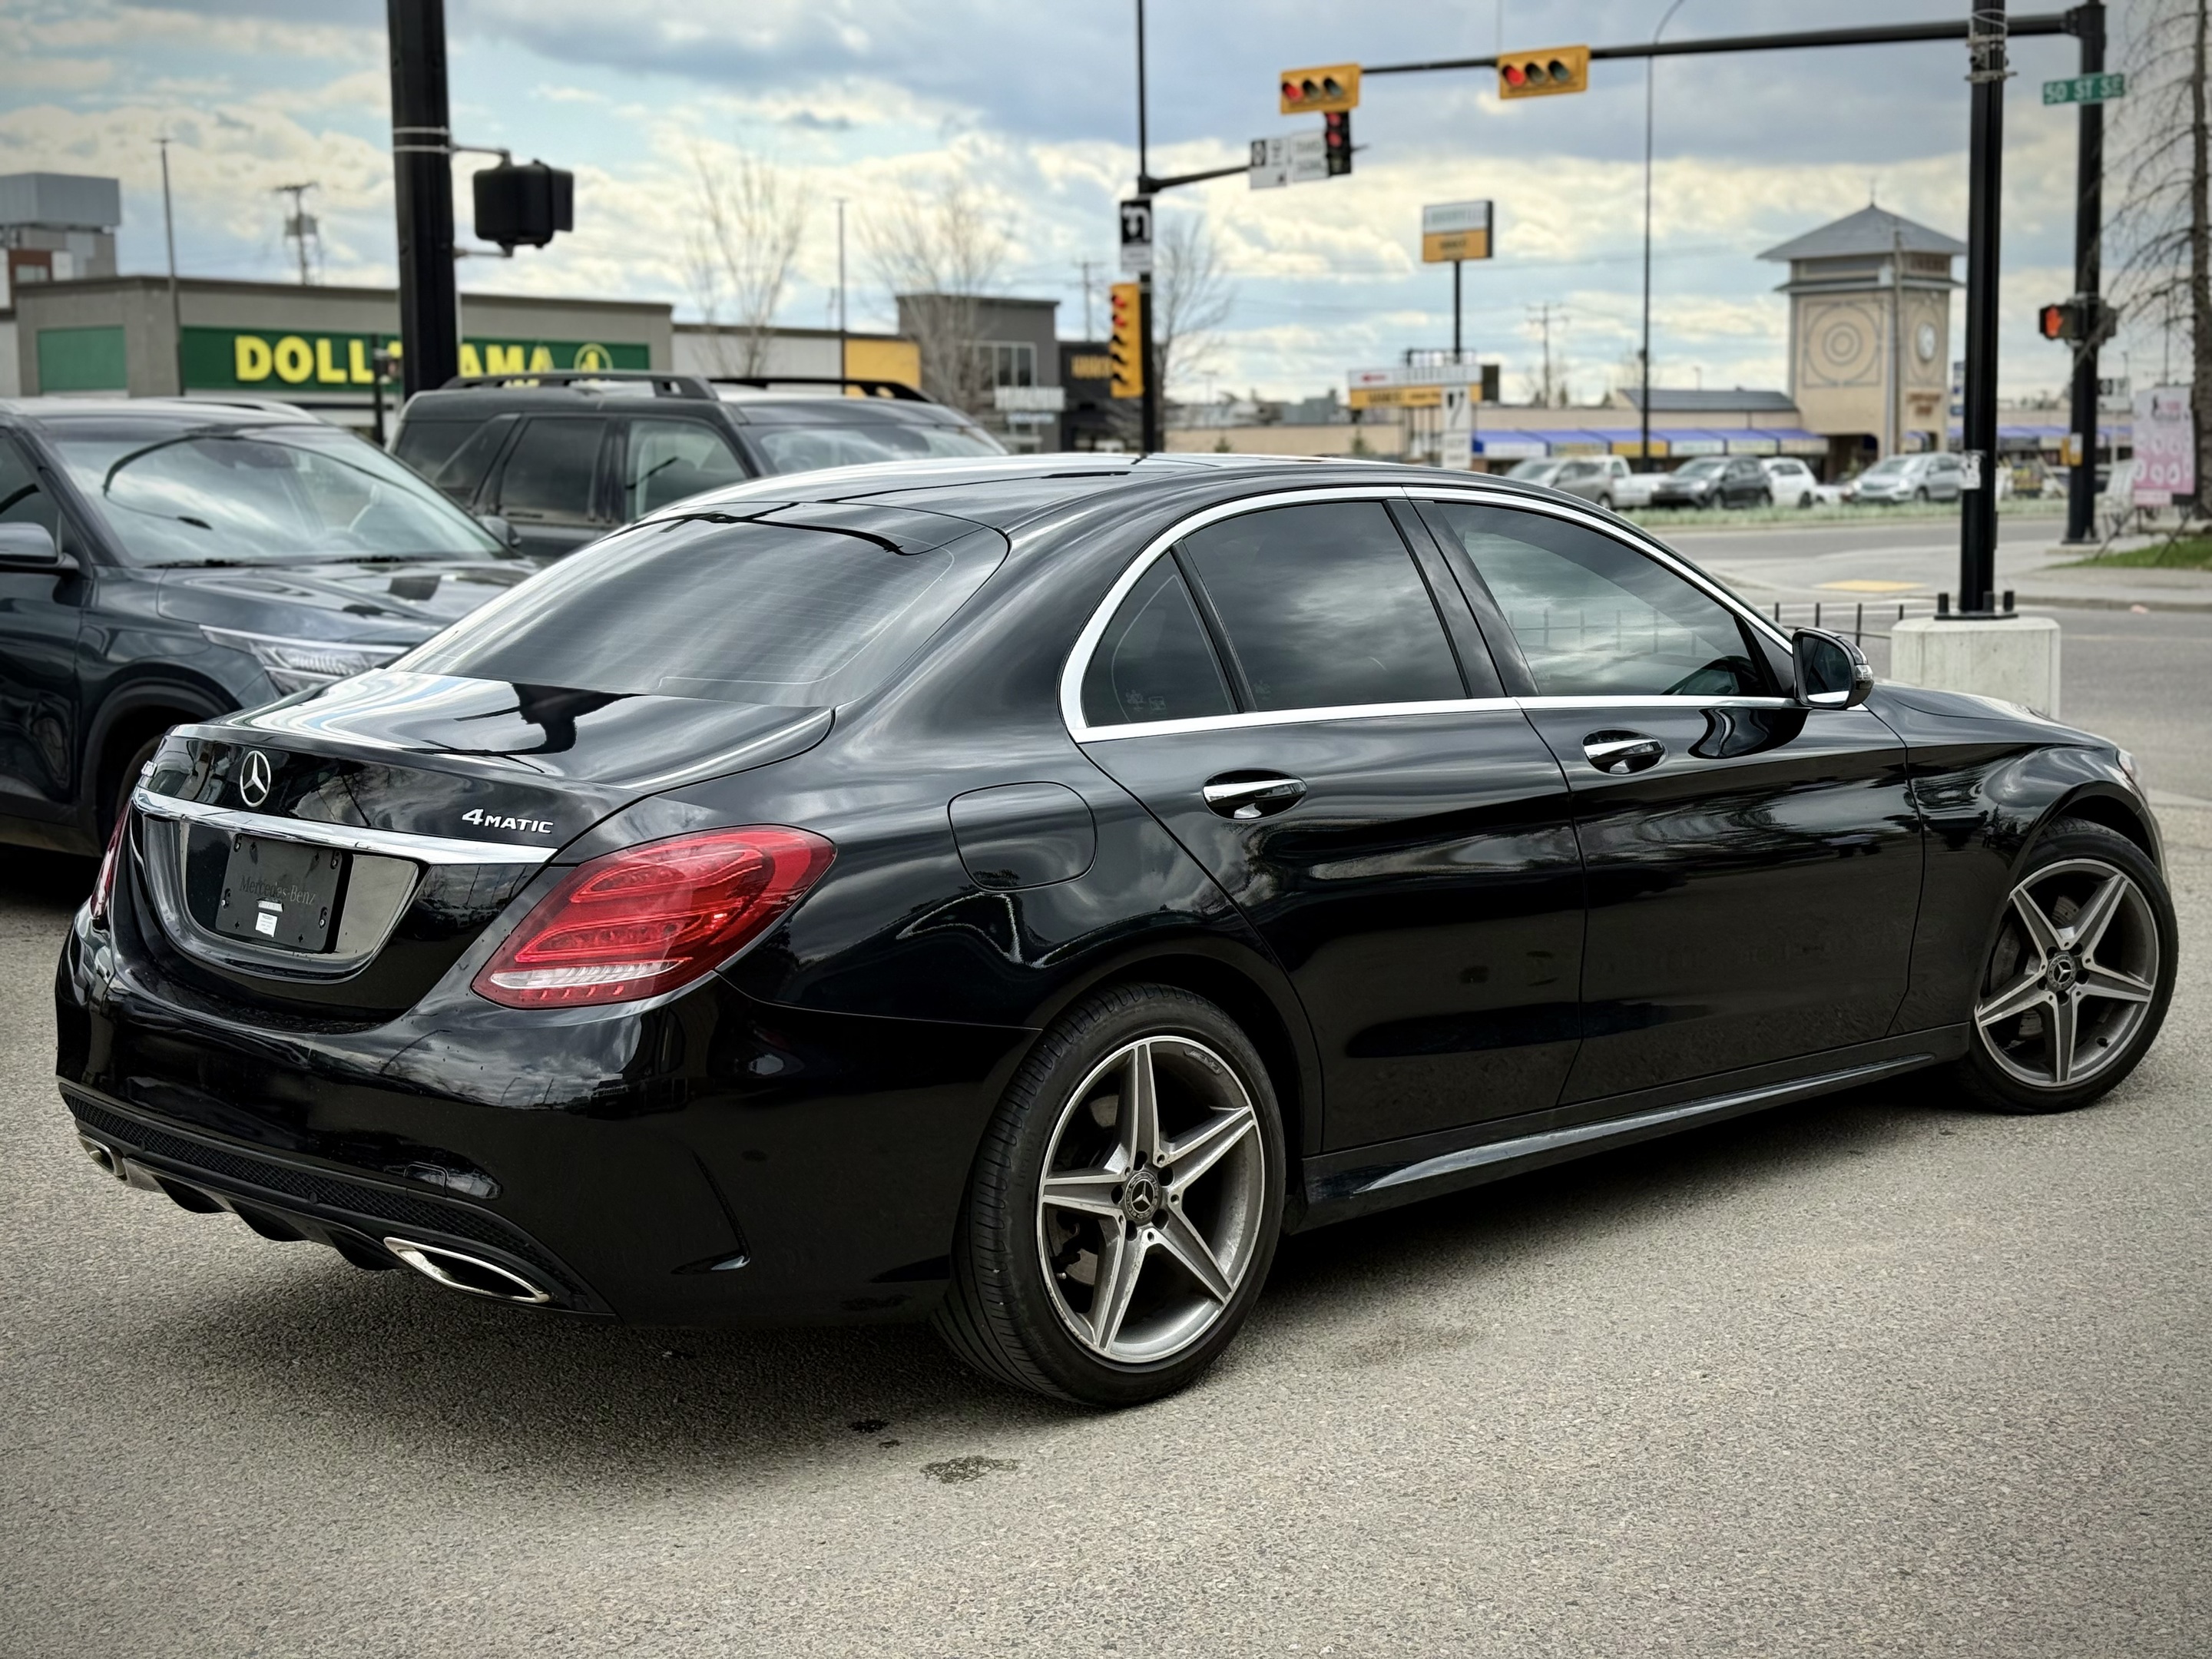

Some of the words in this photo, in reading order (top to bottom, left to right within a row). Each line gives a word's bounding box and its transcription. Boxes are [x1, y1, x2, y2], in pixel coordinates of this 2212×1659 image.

[2045, 81, 2067, 103] 50
[2075, 79, 2093, 100] ST
[235, 335, 555, 387] DOLLAMA
[462, 809, 554, 833] 4MATIC
[240, 876, 316, 906] Mercedes-Benz
